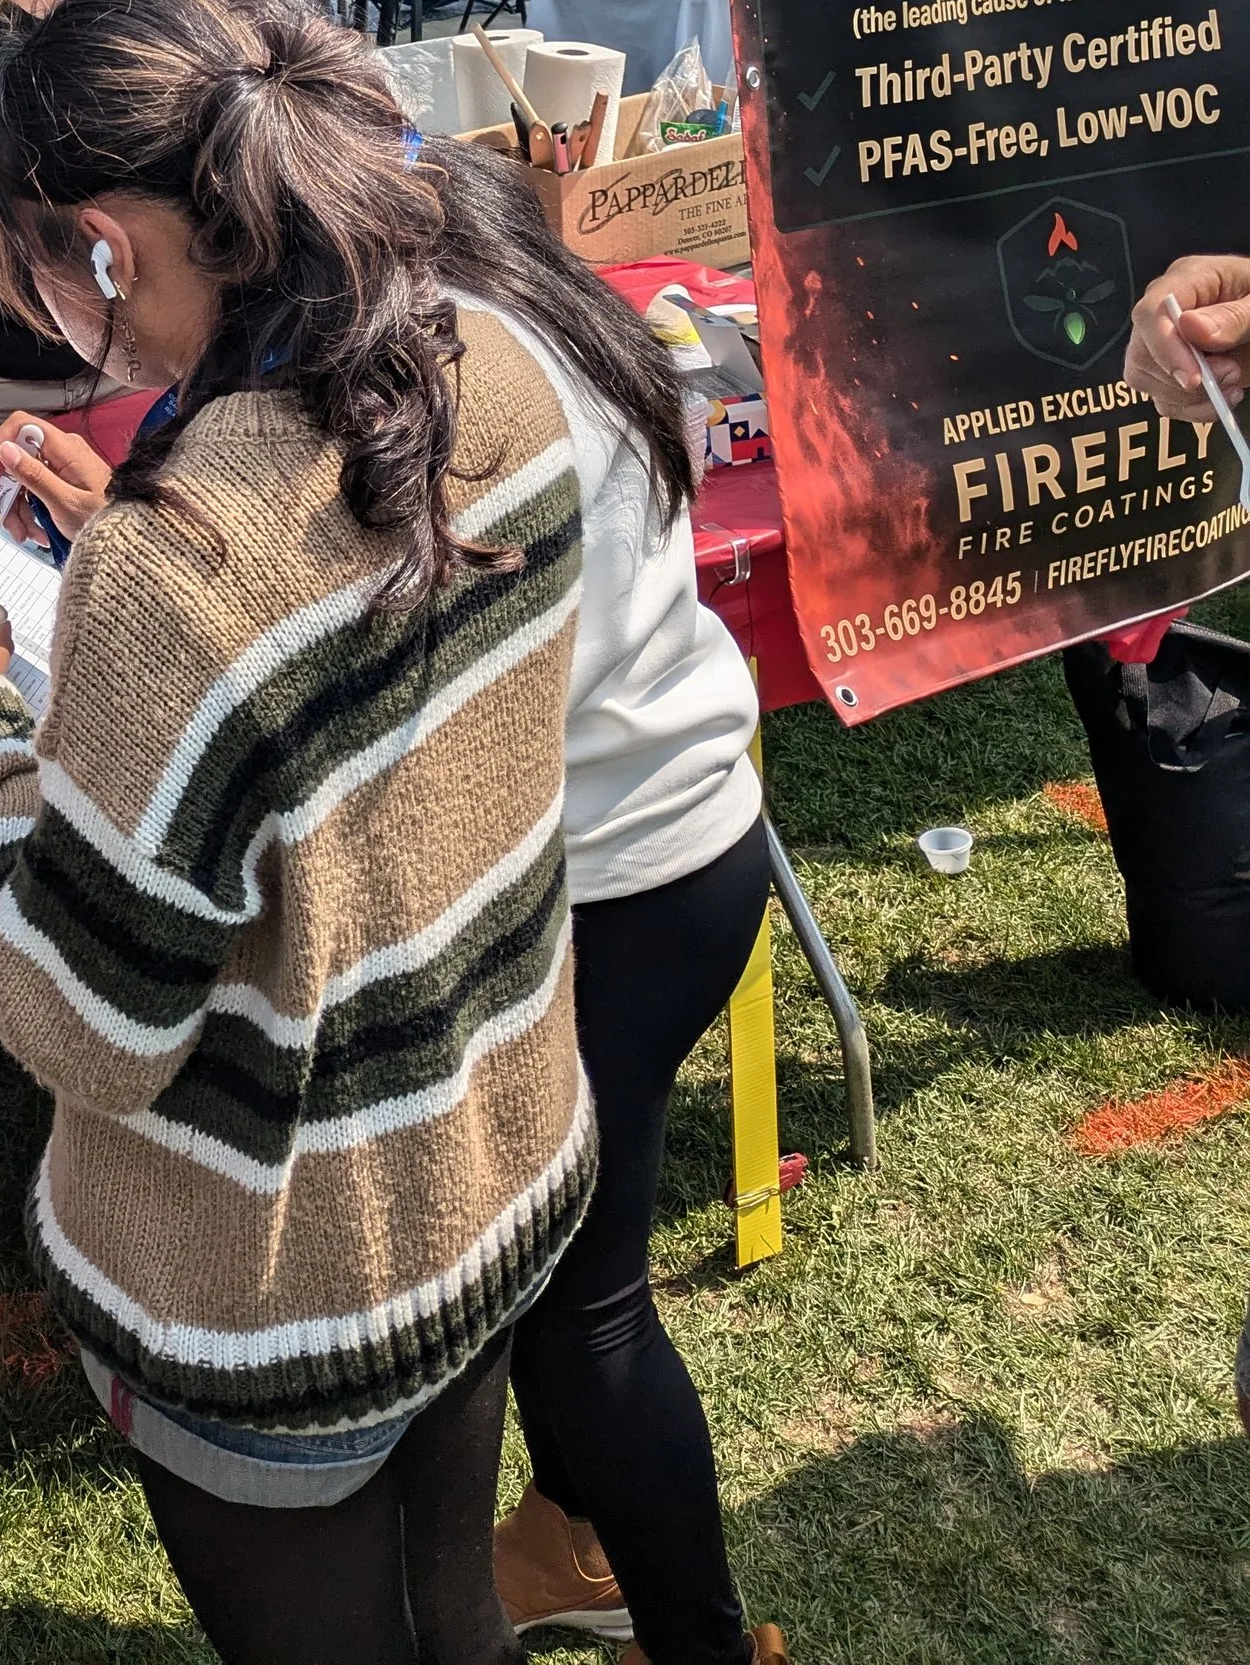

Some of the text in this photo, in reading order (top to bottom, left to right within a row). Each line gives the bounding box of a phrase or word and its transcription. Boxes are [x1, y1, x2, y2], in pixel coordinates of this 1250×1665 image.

[853, 5, 896, 40] (the
[855, 9, 1222, 108] Third-Party Certified
[858, 83, 1221, 183] PFAS-Free, Low-VOC
[678, 205, 703, 221] THE
[705, 197, 731, 215] FINE
[941, 399, 1035, 445] APPLIED
[951, 416, 1215, 522] FIREFLY
[957, 469, 1215, 560] FIRE COATINGS
[820, 570, 1023, 664] 303-669-8845
